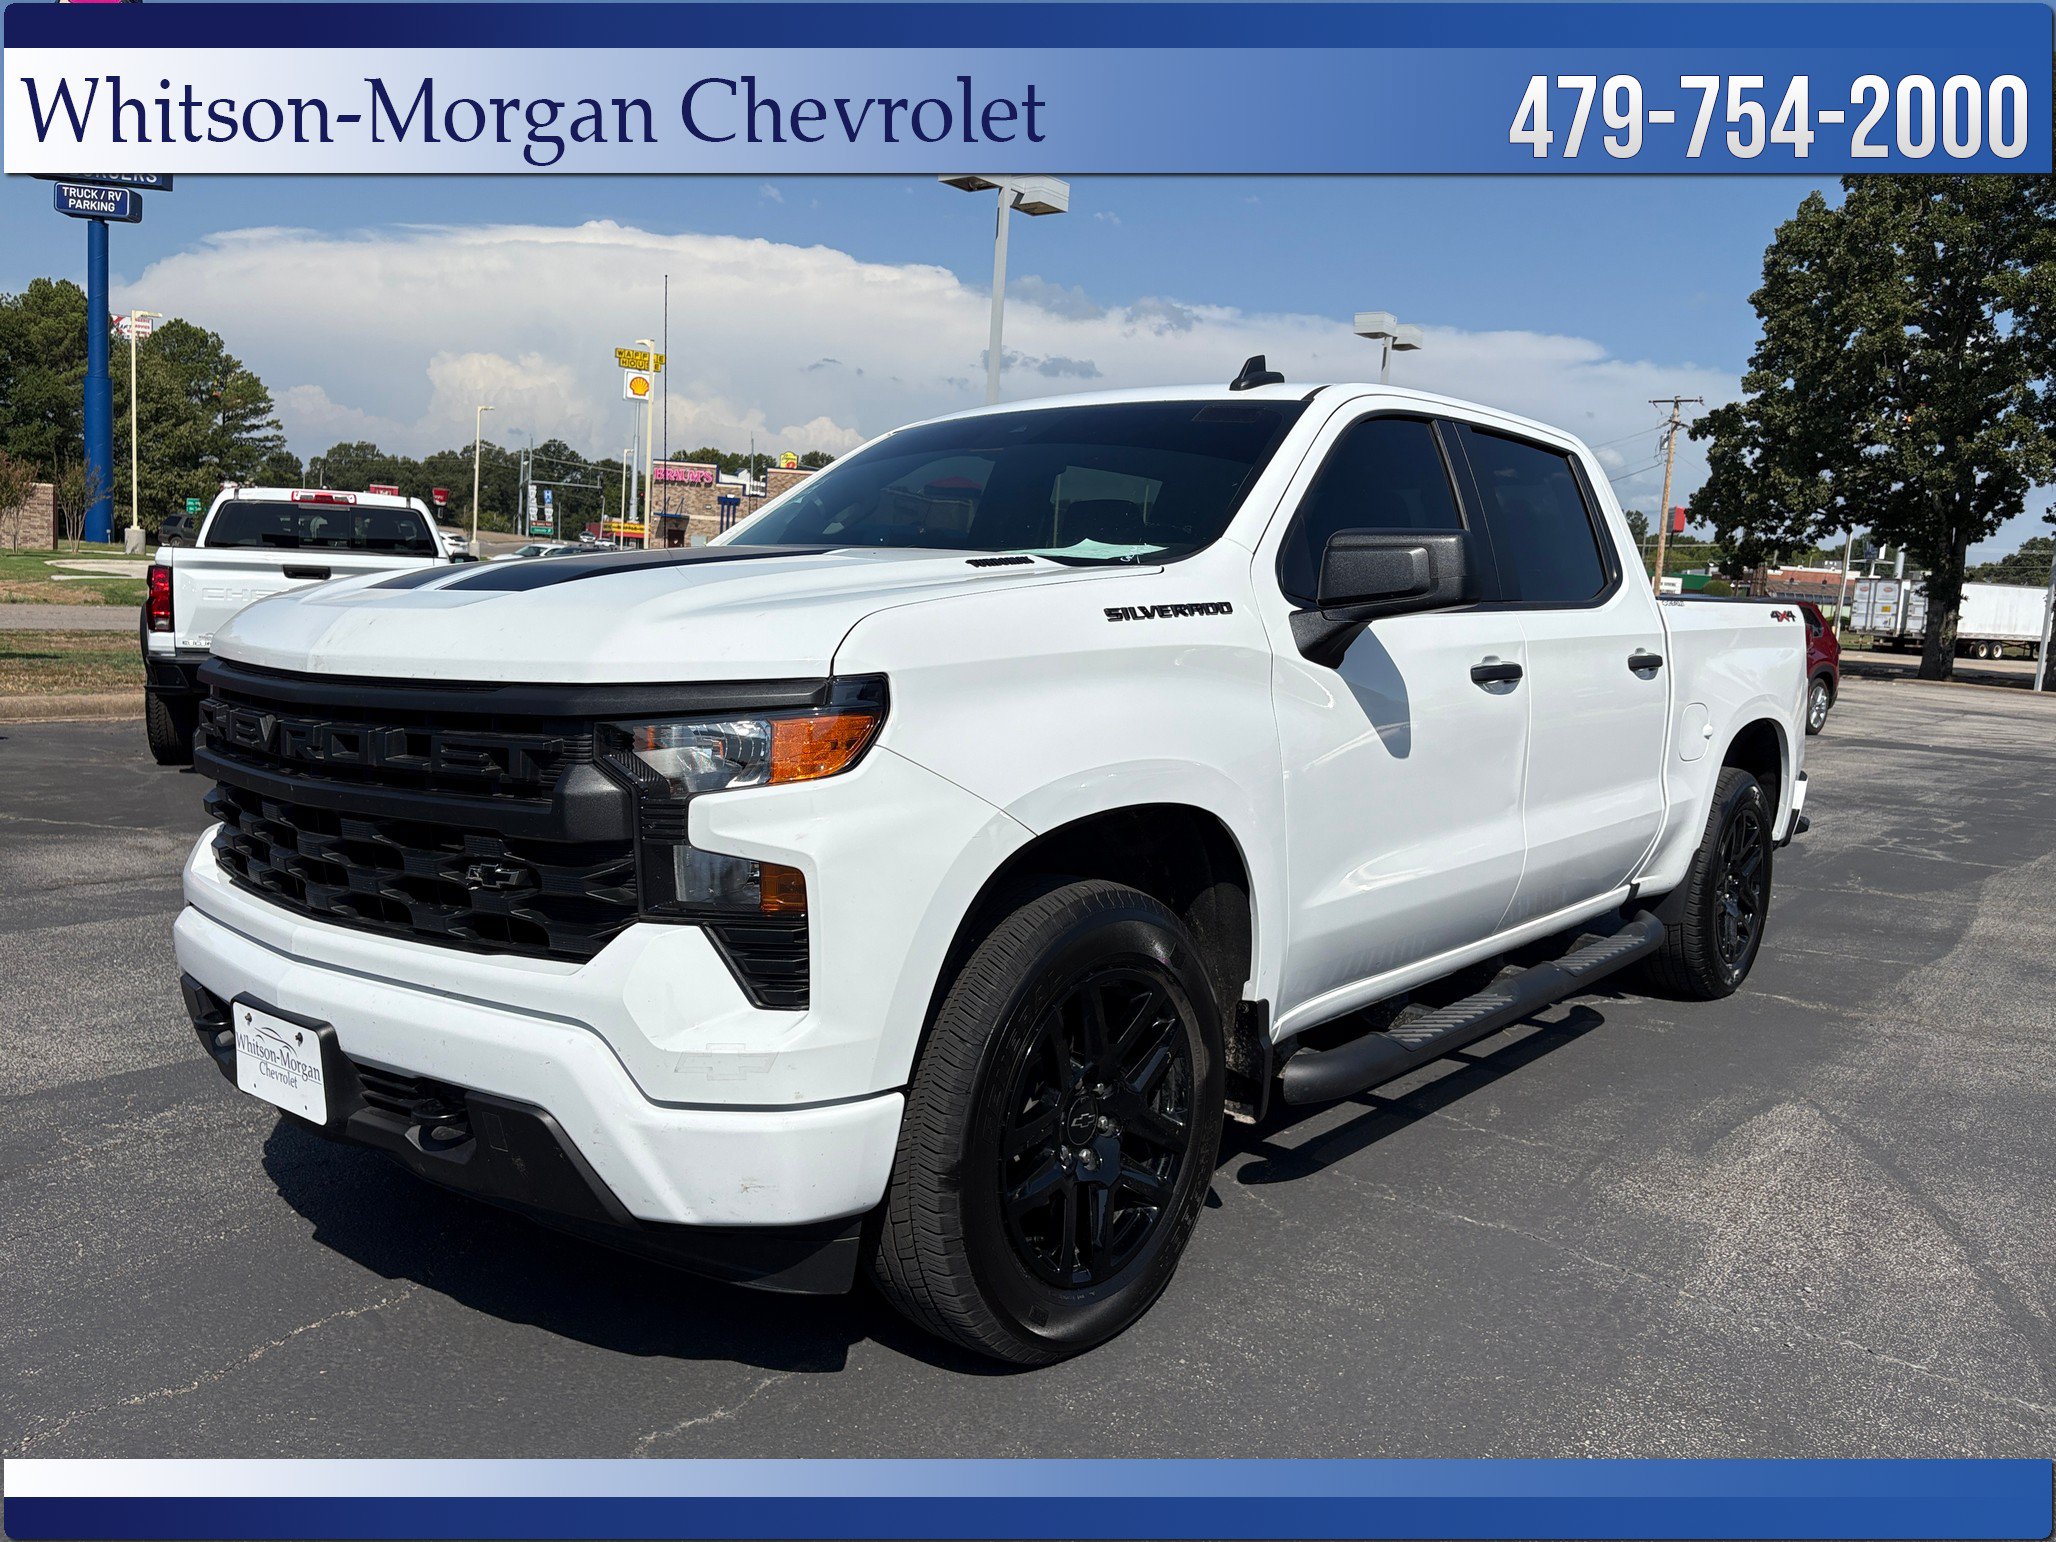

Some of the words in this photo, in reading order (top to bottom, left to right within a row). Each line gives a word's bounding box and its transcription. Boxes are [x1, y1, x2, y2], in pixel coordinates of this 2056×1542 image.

[62, 186, 98, 199] TRUCK
[107, 191, 122, 201] RV
[68, 199, 116, 212] PARKING
[617, 350, 664, 364] WAFFE
[1103, 601, 1234, 623] SILVERADO
[235, 1032, 322, 1083] Whitson-Morgan
[259, 1061, 298, 1090] Chevrolet
